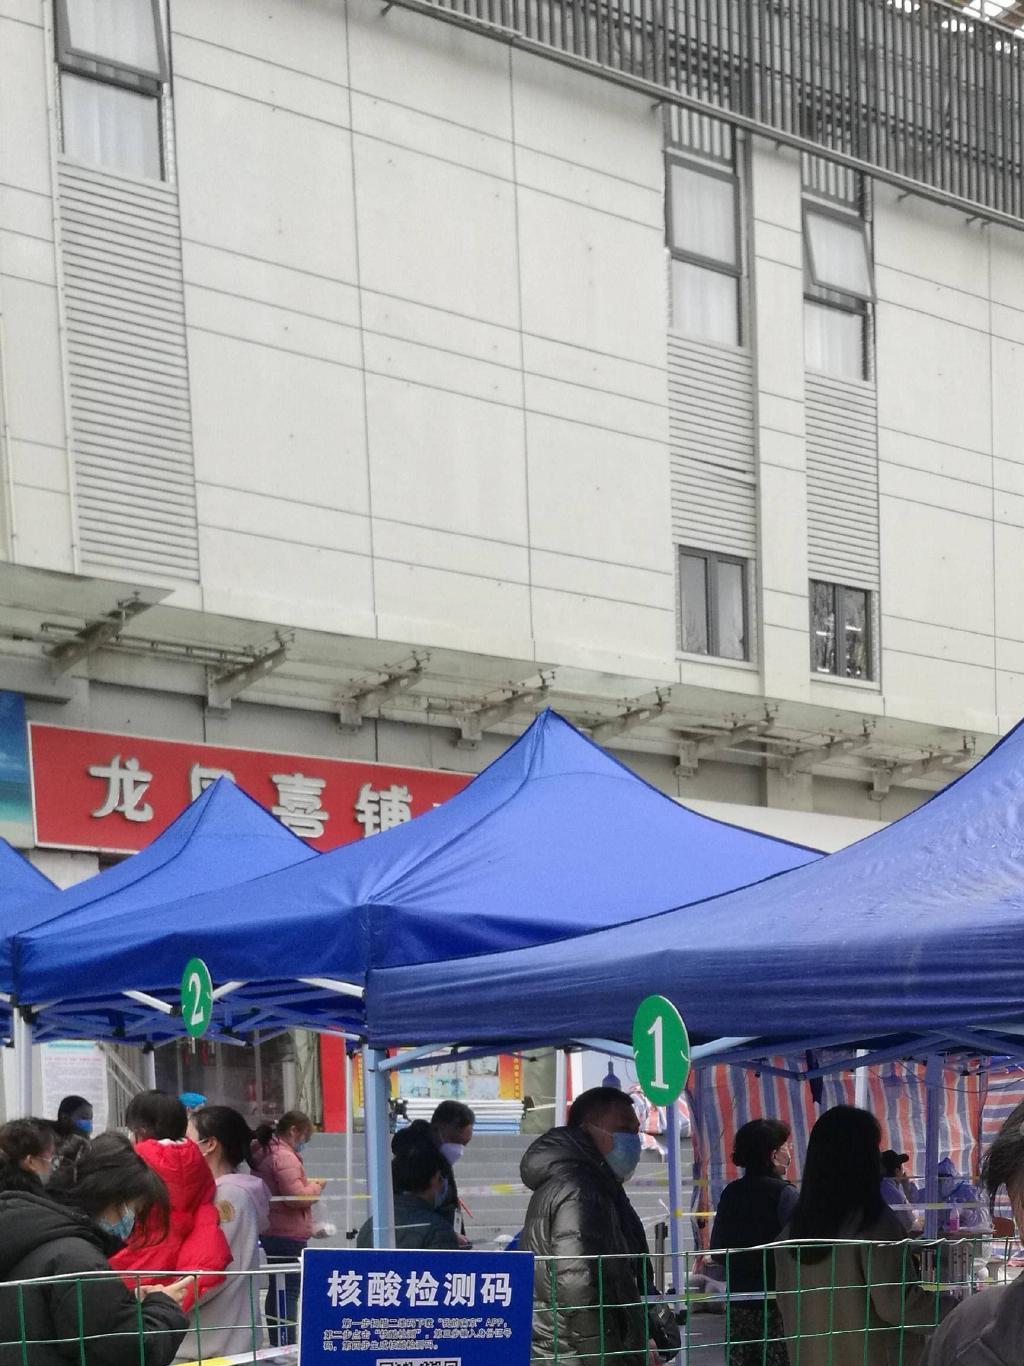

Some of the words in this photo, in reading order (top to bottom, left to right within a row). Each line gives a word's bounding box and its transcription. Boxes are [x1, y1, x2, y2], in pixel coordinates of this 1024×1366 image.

[187, 972, 206, 1027] 2
[645, 1014, 669, 1090] 1
[327, 1269, 512, 1308] 核酸检测码
